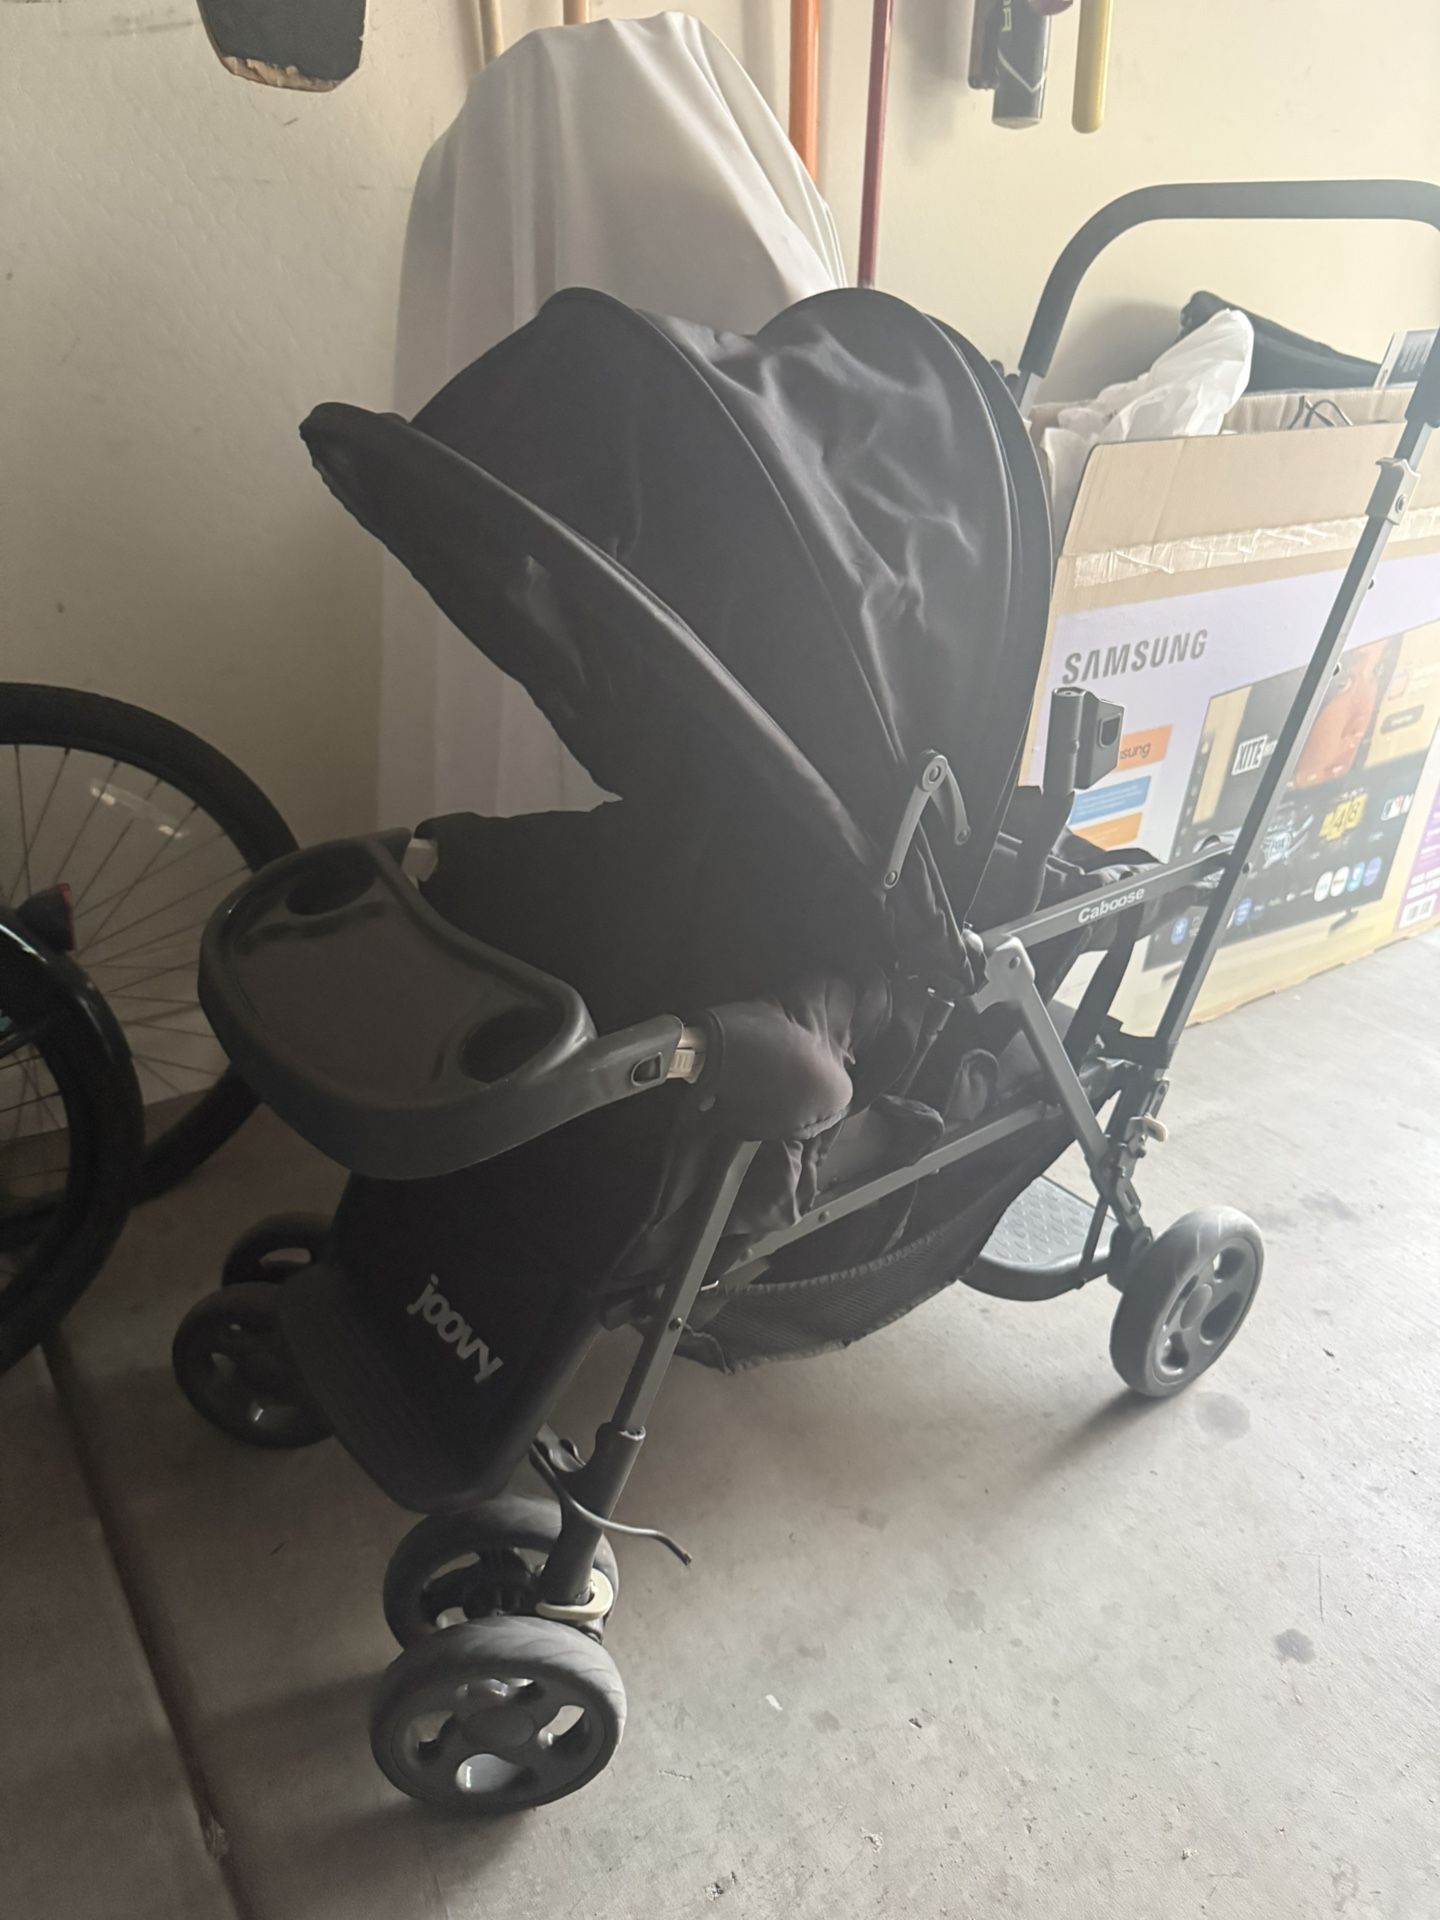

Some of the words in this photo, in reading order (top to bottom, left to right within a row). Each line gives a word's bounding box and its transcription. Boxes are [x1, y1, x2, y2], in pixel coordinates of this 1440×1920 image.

[1062, 629, 1208, 685] SAMSUNG
[1119, 742, 1151, 760] sung
[1078, 888, 1145, 923] Caboose
[406, 1273, 504, 1385] joovy
